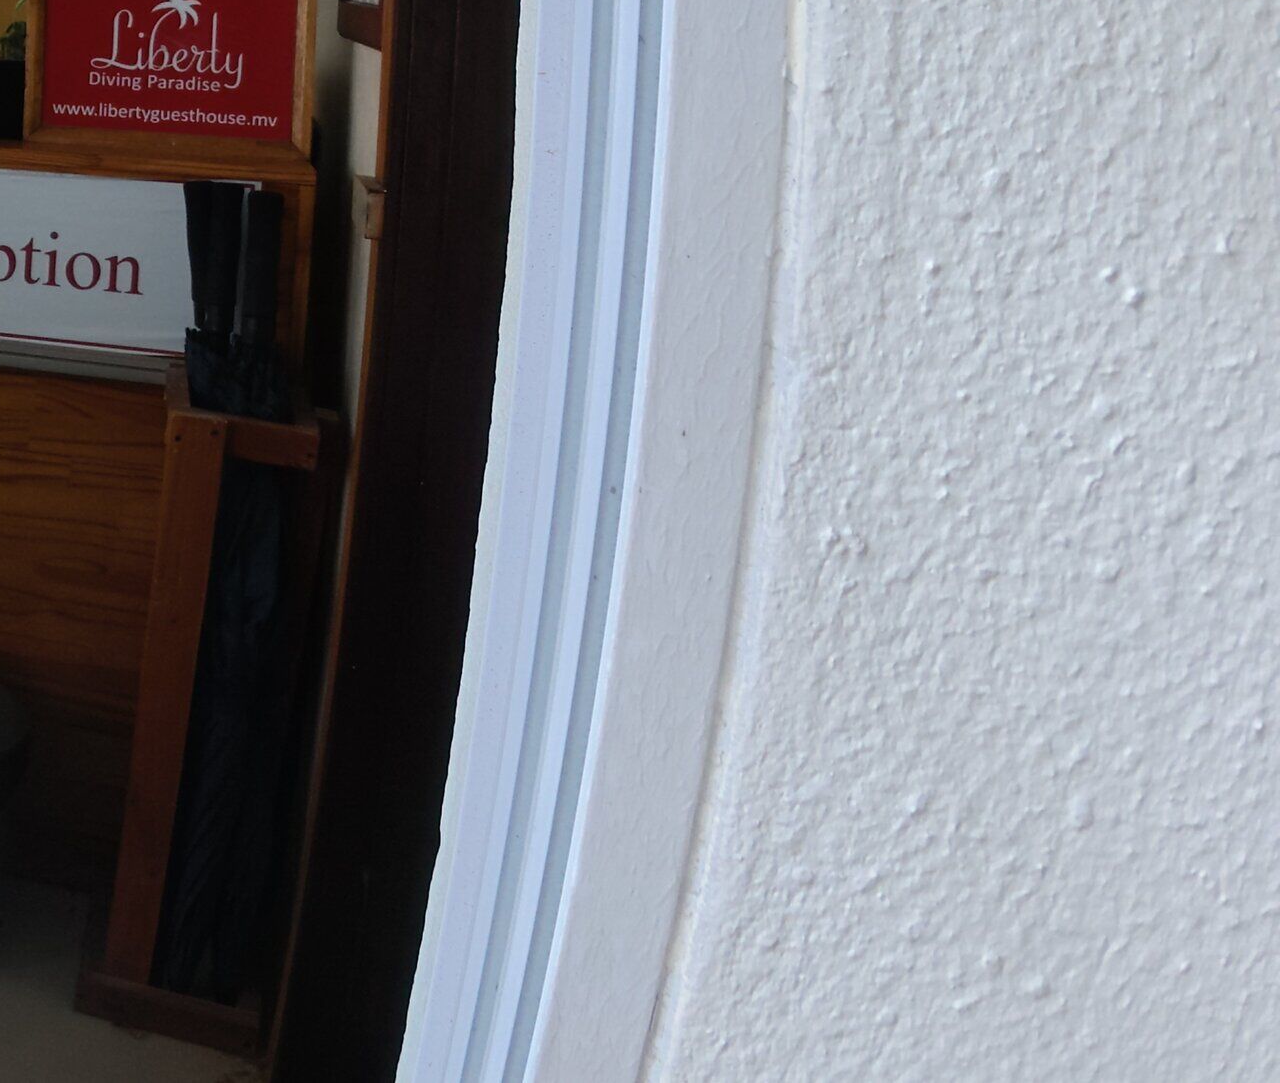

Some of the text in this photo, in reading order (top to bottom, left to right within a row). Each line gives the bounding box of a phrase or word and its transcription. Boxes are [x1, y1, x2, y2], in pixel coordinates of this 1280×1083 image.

[90, 7, 243, 89] Liberty
[89, 71, 221, 92] Diving Paradise
[52, 102, 278, 127] www.libertyguesthouse.mv
